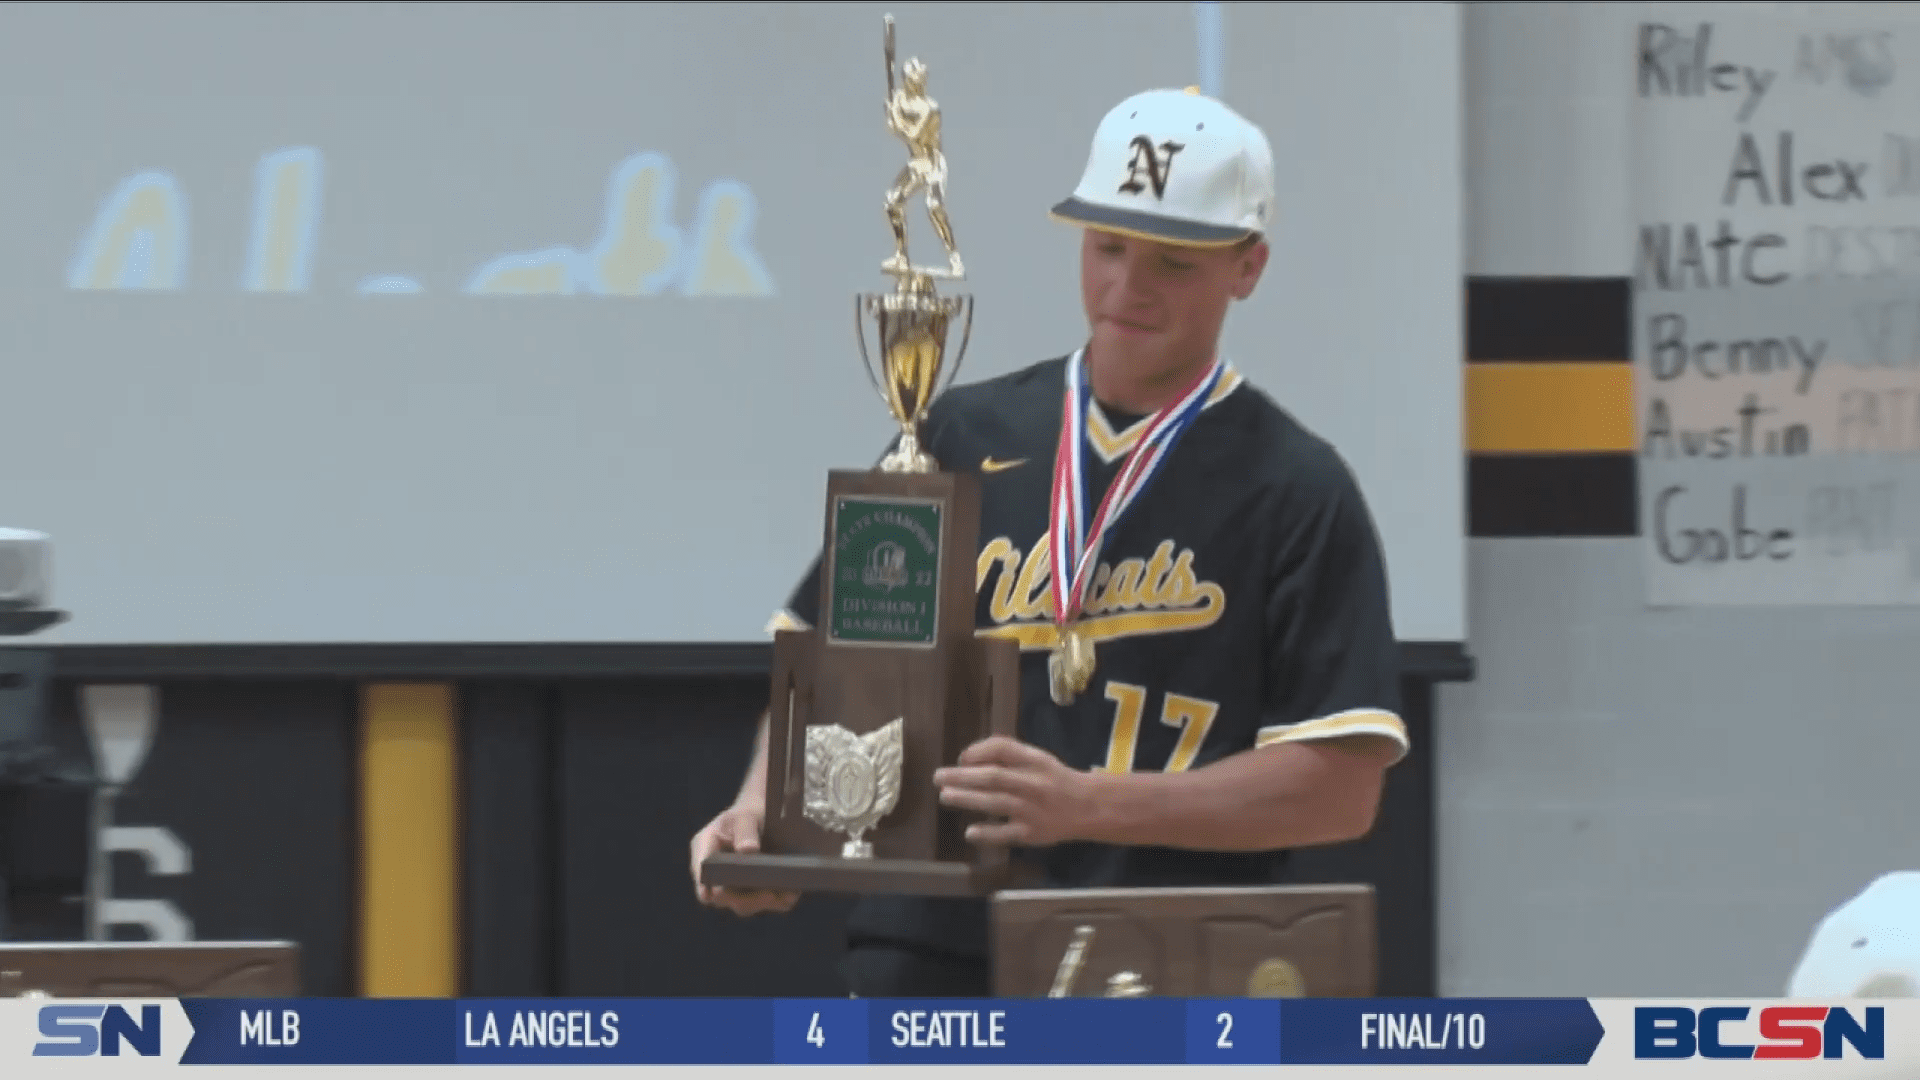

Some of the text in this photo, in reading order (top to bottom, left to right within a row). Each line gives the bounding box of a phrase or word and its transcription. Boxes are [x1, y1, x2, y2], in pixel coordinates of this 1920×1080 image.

[1638, 22, 1777, 122] Riley
[1117, 134, 1186, 201] N
[1721, 131, 1869, 206] Alex
[1650, 312, 1828, 396] Benny
[1645, 394, 1810, 460] Austin
[1654, 484, 1794, 565] Gabe
[1103, 680, 1220, 773] 17
